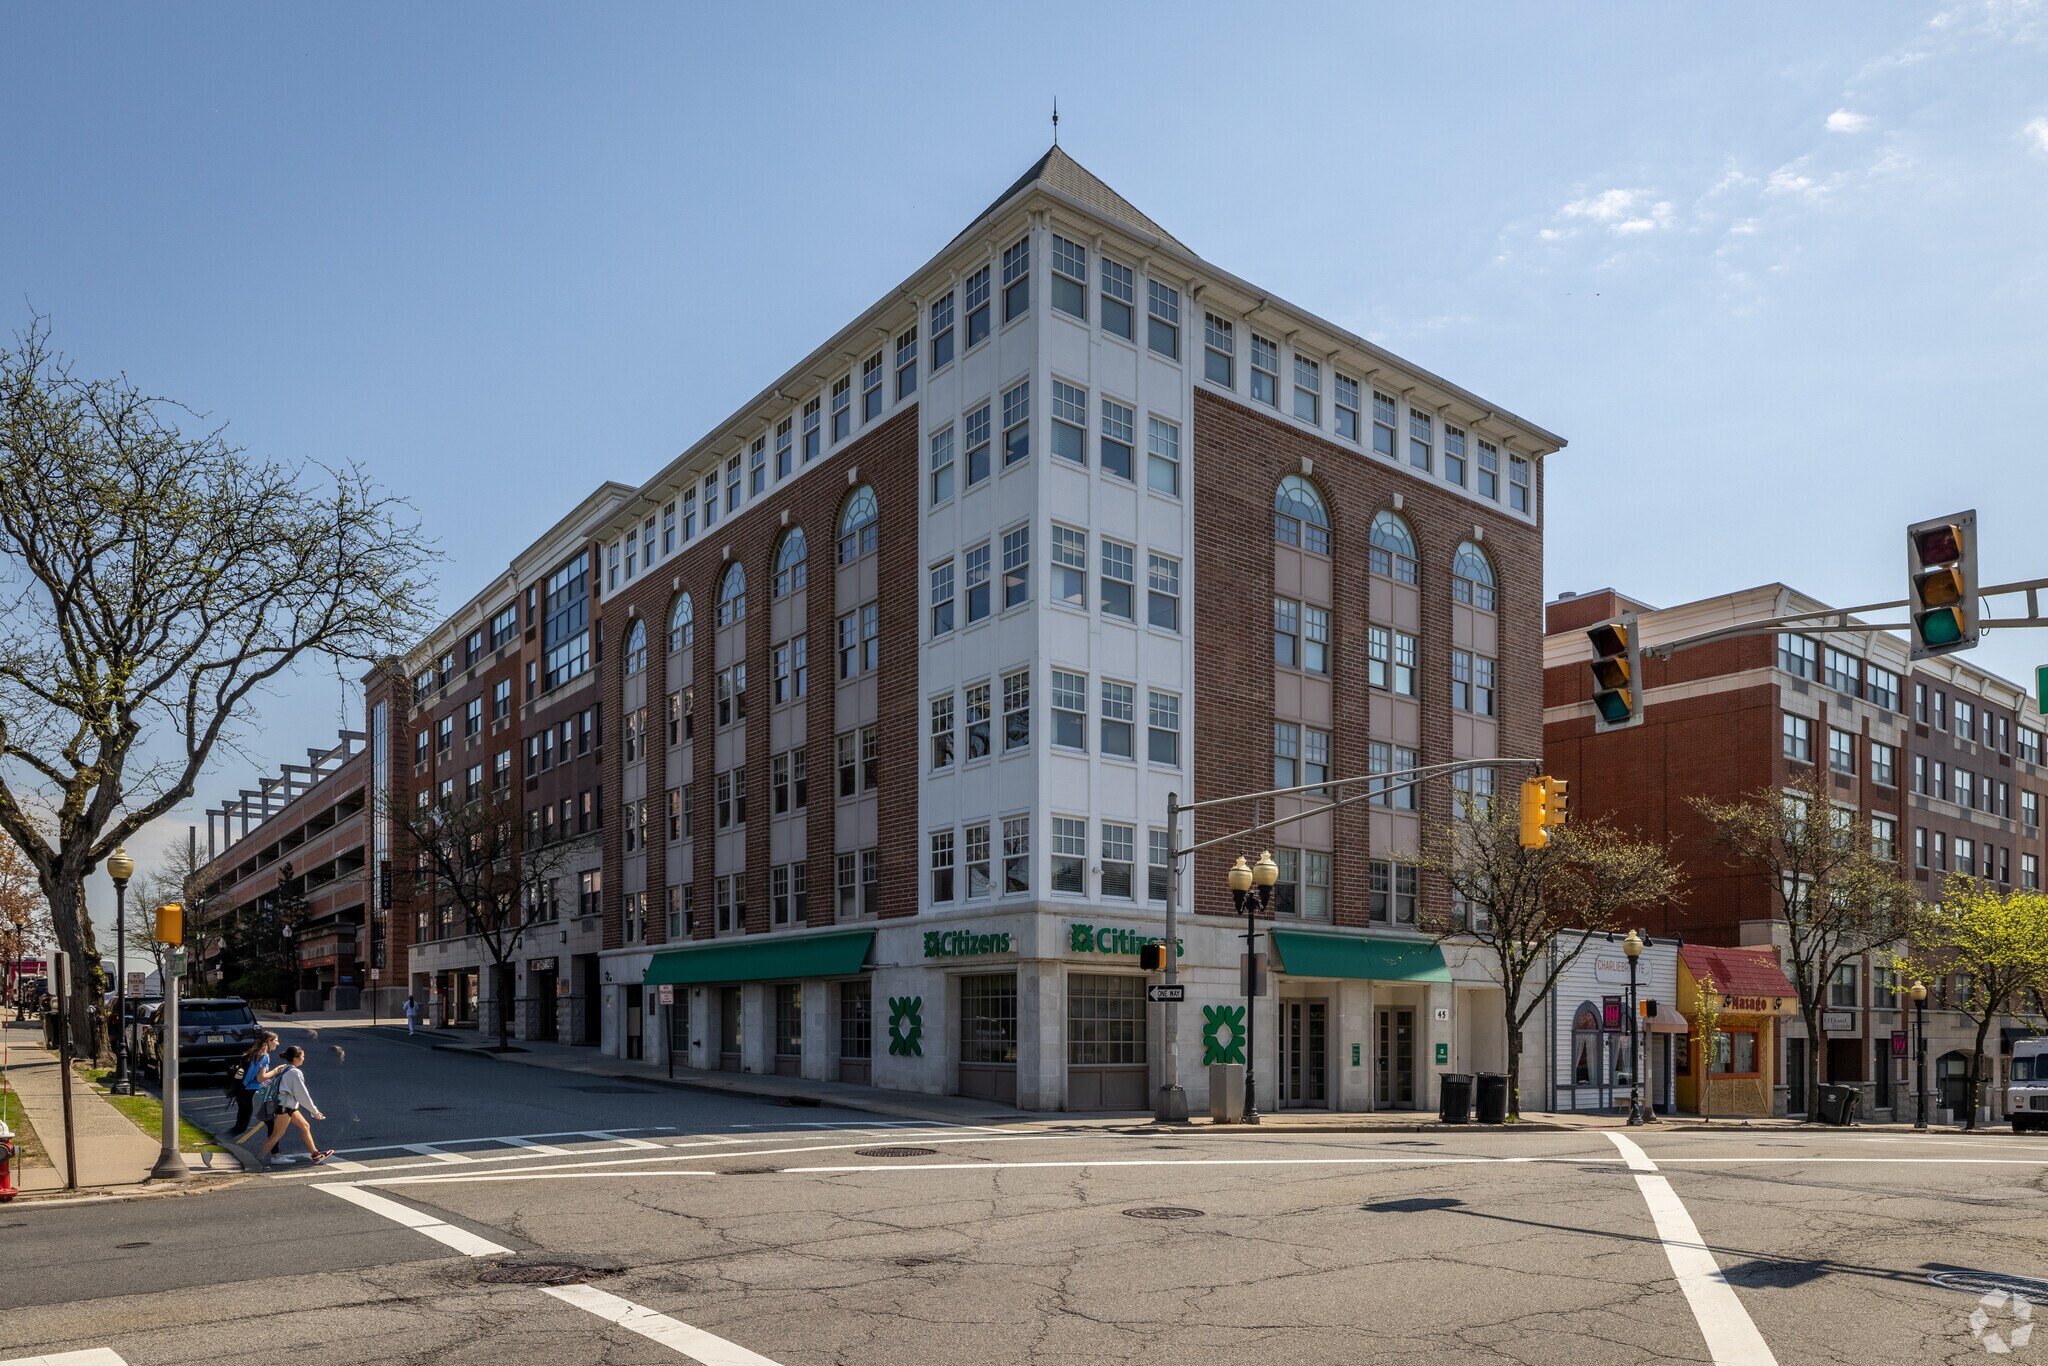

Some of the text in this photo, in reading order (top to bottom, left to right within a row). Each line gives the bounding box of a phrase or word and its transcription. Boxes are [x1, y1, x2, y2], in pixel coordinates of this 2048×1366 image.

[940, 929, 1010, 957] Citizens
[1096, 927, 1184, 957] Citizs
[1437, 1010, 1446, 1019] 45
[1731, 996, 1767, 1012] Masago
